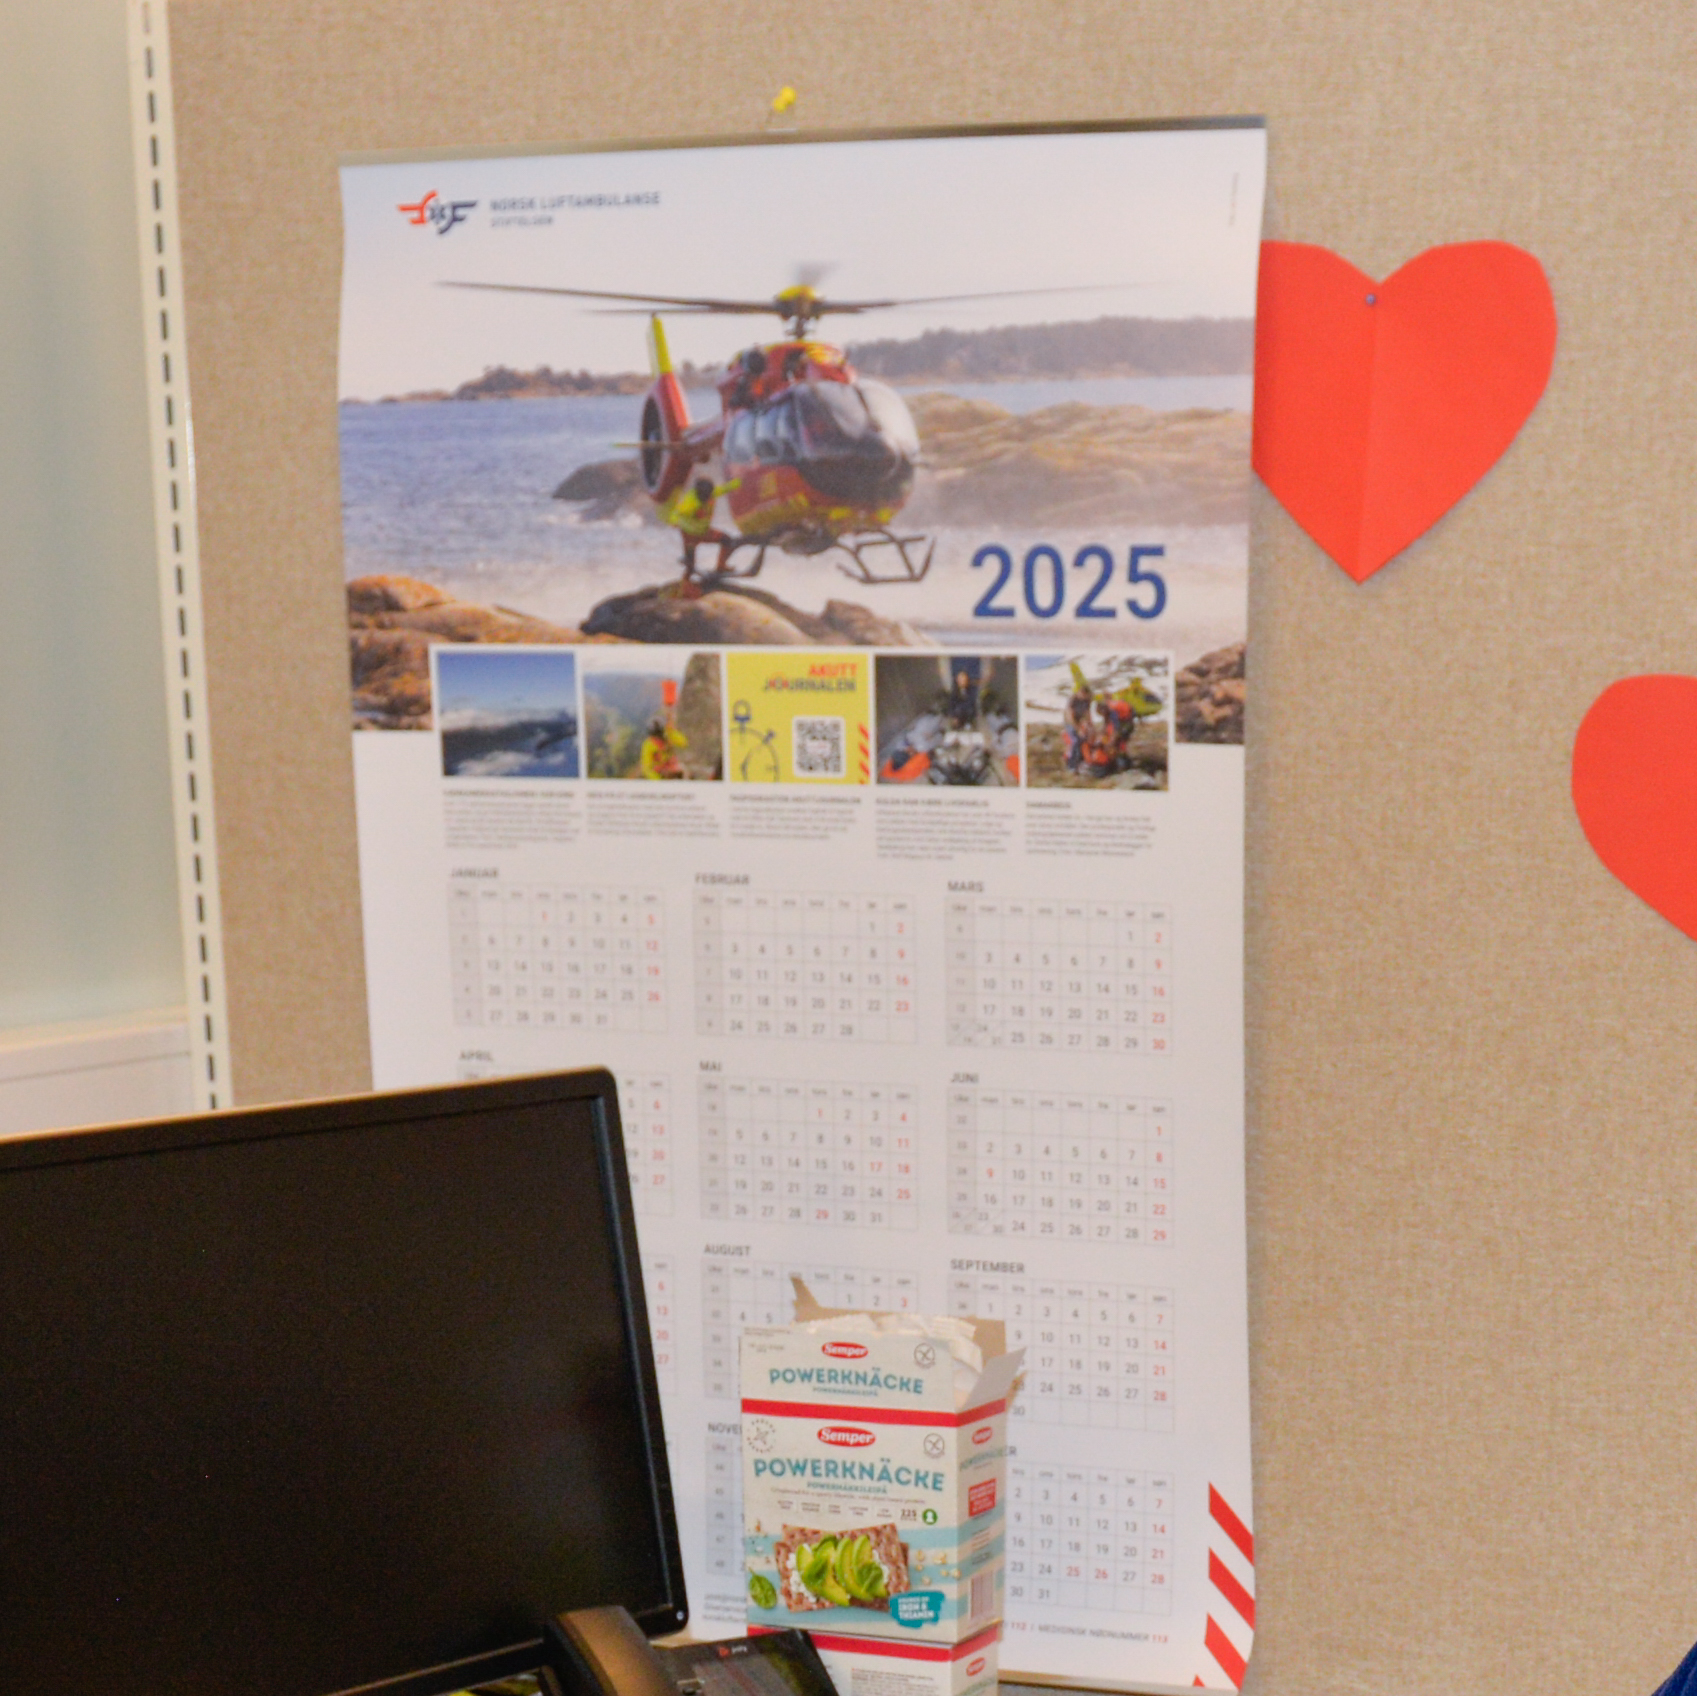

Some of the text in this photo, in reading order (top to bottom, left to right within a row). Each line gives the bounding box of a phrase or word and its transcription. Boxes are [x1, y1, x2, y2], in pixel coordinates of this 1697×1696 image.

[971, 544, 1168, 620] 2025
[809, 662, 858, 677] AKUTT
[695, 873, 750, 885] FEBRUAR
[947, 880, 985, 893] MARS
[699, 1060, 722, 1072] MAI
[950, 1072, 980, 1084] JUNI
[704, 1243, 751, 1257] AUGUST
[950, 1258, 1026, 1274] SEPTEMBER
[823, 1343, 867, 1358] Semper
[769, 1366, 924, 1395] POWERKNÄCKE
[820, 1427, 874, 1446] Semper
[753, 1457, 946, 1492] POWERKNÄCKE
[1015, 1512, 1165, 1534] 9 10 11 12 13 14
[1013, 1536, 1164, 1559] 16 17 18 19 20 21
[1011, 1561, 1164, 1584] 23 24 25 26 27 28
[1011, 1586, 1050, 1599] 30 31
[899, 1610, 934, 1619] THIAMIN
[1010, 1622, 1027, 1631] 112
[1153, 1635, 1168, 1643] 113
